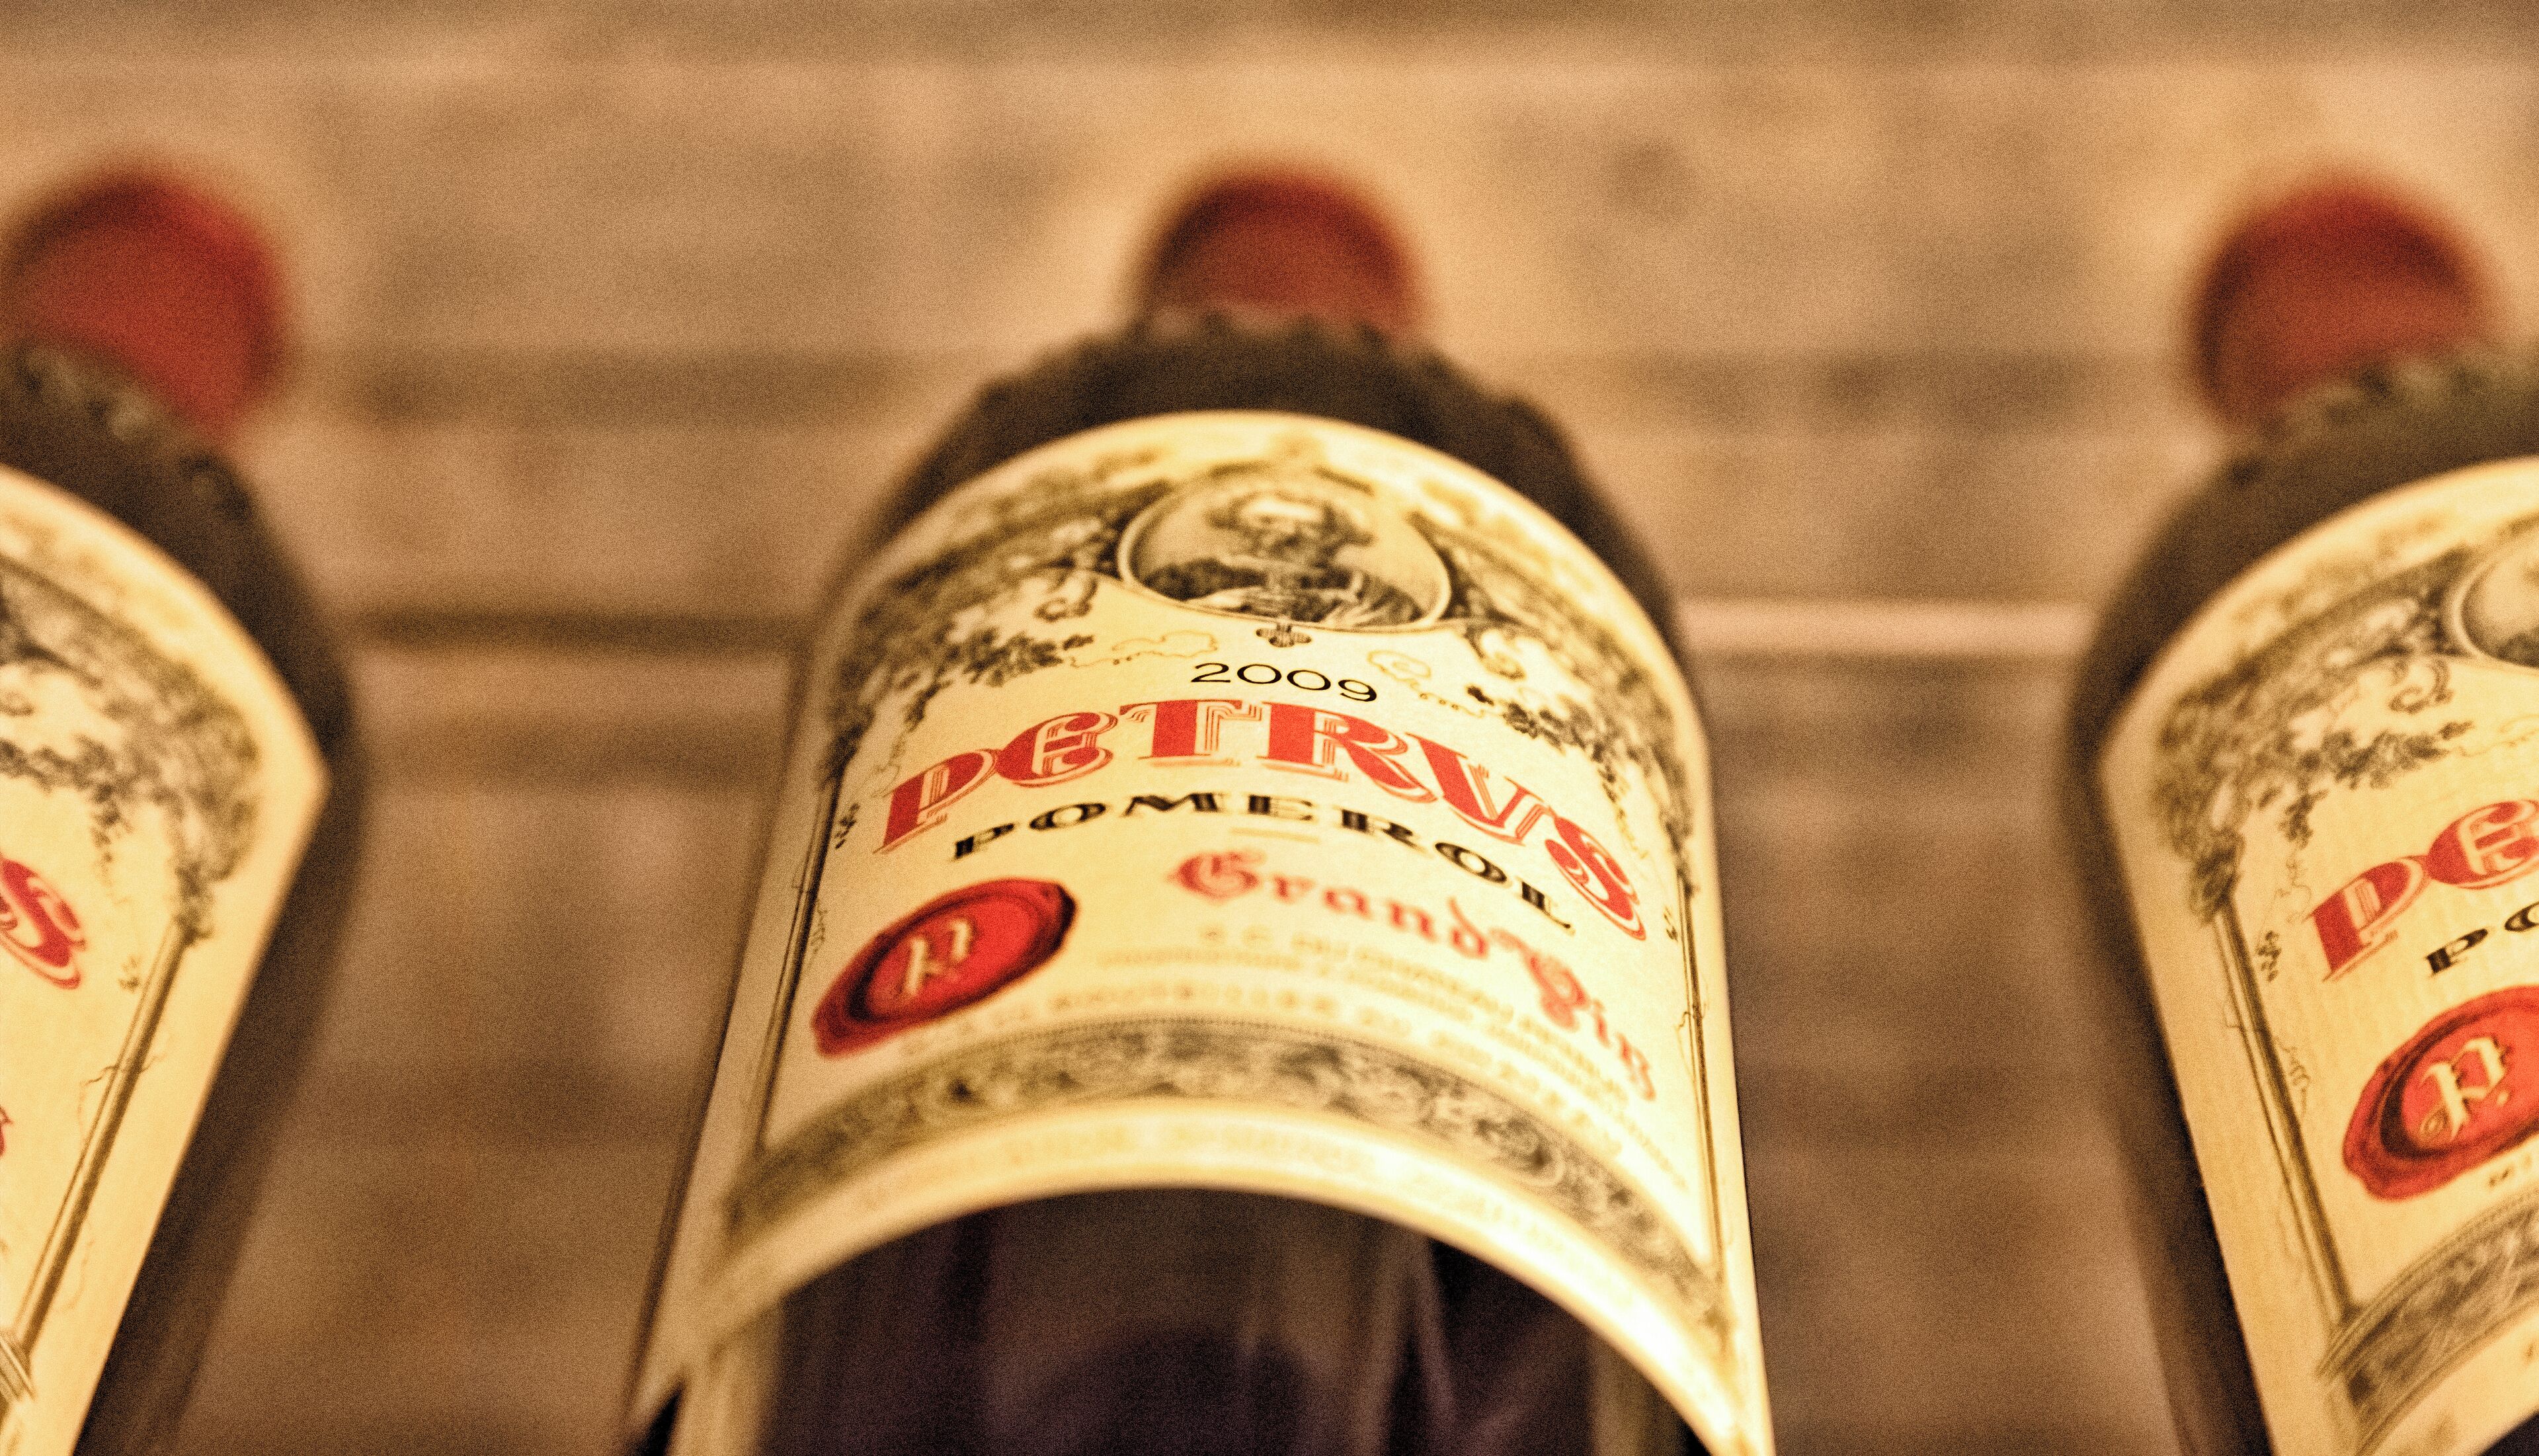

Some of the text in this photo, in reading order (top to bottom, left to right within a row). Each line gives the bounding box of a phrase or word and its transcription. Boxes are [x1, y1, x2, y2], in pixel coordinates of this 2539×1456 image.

[1191, 662, 1378, 703] 2009
[950, 791, 1576, 936] POMEROL
[1168, 848, 1490, 960] Grand
